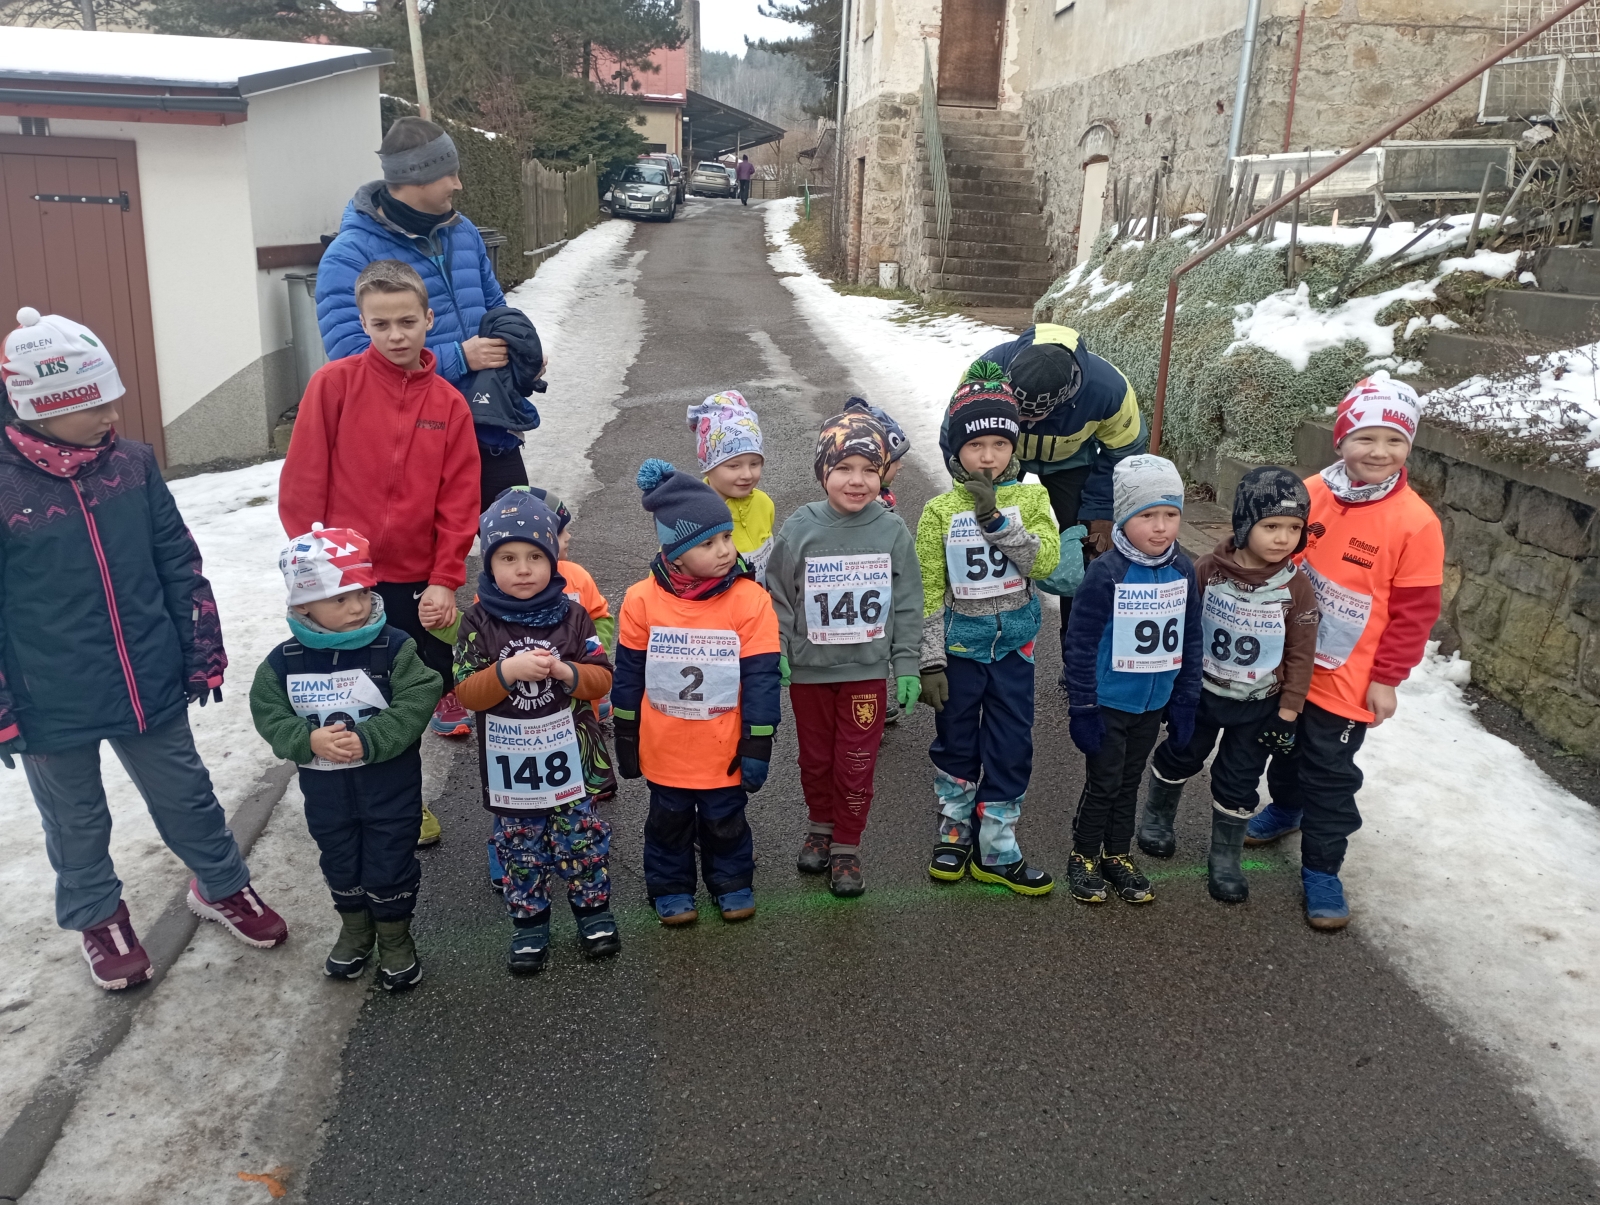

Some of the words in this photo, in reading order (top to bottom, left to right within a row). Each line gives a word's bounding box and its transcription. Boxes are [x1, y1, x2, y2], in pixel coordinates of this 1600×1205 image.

[35, 360, 69, 378] LES
[29, 383, 99, 410] MARATON
[807, 560, 843, 574] ZIMNÍ
[966, 545, 1009, 582] 59
[1343, 552, 1374, 567] MARATON
[807, 572, 861, 584] BĚŽECKÁ
[863, 572, 888, 581] LIGA
[1118, 588, 1158, 600] ZIMNÍ
[1207, 592, 1237, 613] ZIMNÍ
[1324, 589, 1370, 611] 2024-2025
[813, 590, 882, 626] 146
[1118, 600, 1171, 610] BĚŽECKÁ
[1173, 597, 1186, 608] LIGA
[1206, 603, 1251, 627] BĚŽECKÁ
[1254, 620, 1283, 629] LIGA
[1338, 605, 1365, 621] LIGA
[652, 633, 688, 645] ZIMNÍ
[1135, 617, 1179, 655] 96
[650, 644, 706, 656] BĚŽECKÁ
[709, 648, 736, 657] LIGA
[1211, 627, 1261, 667] 89
[679, 665, 704, 702] 2
[488, 721, 521, 736] ZIMNÍ
[524, 719, 571, 735] 2024-2025
[488, 734, 543, 747] BĚŽECKÁ
[546, 728, 573, 744] LIGA
[495, 750, 572, 791] 148
